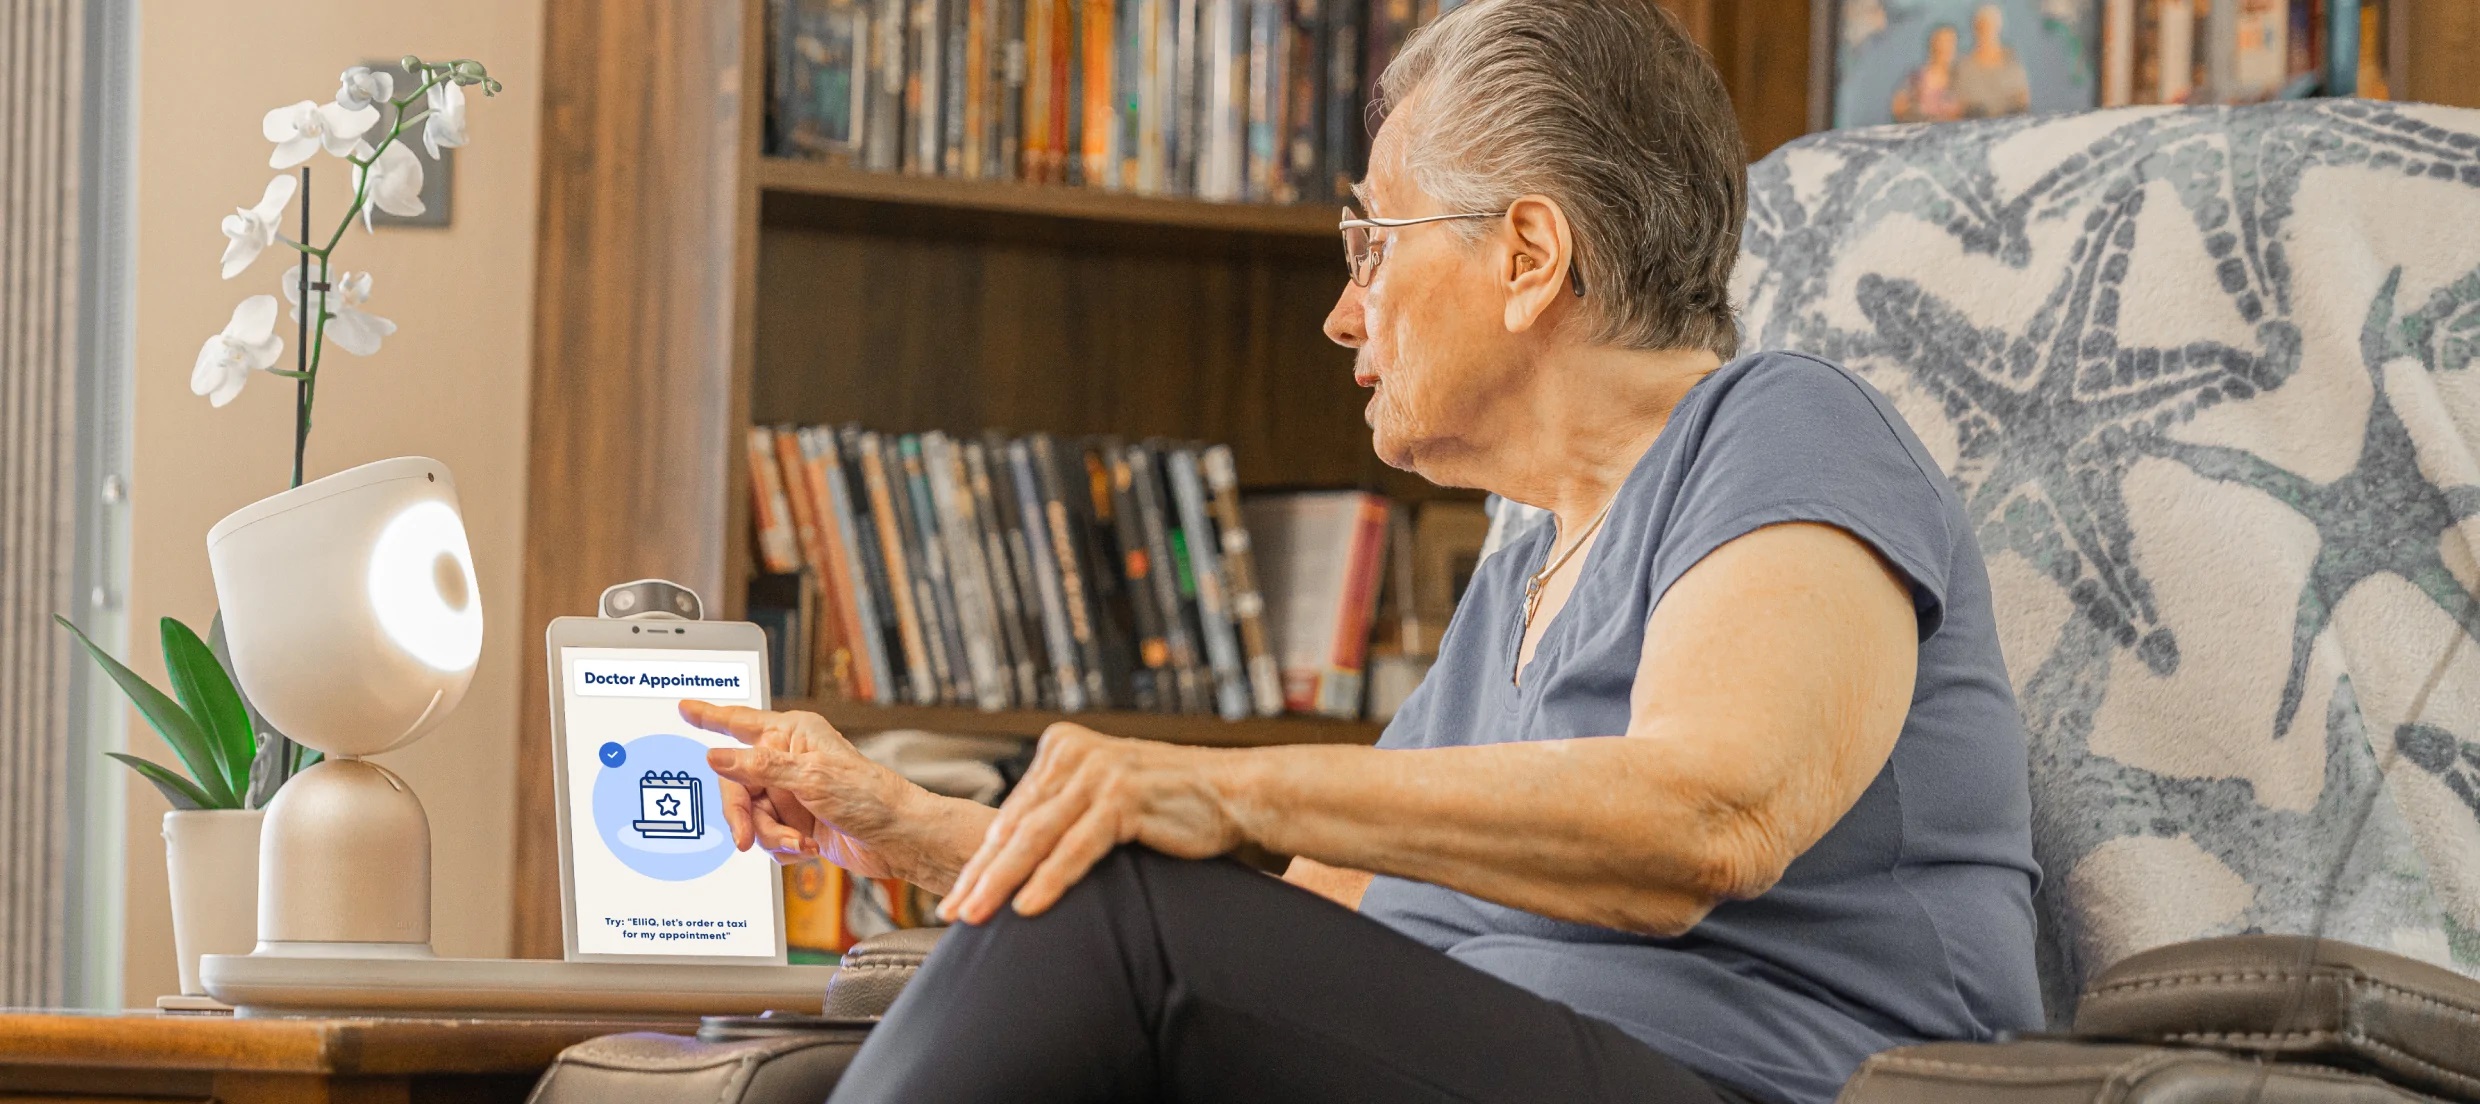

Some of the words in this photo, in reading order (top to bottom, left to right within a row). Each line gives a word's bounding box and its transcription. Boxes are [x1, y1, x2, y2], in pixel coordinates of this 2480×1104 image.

[584, 671, 635, 686] Doctor
[639, 672, 740, 689] Appointment
[604, 917, 625, 928] Try:
[686, 919, 715, 928] order
[726, 919, 747, 928] taxi
[622, 929, 638, 939] for
[640, 932, 656, 941] my
